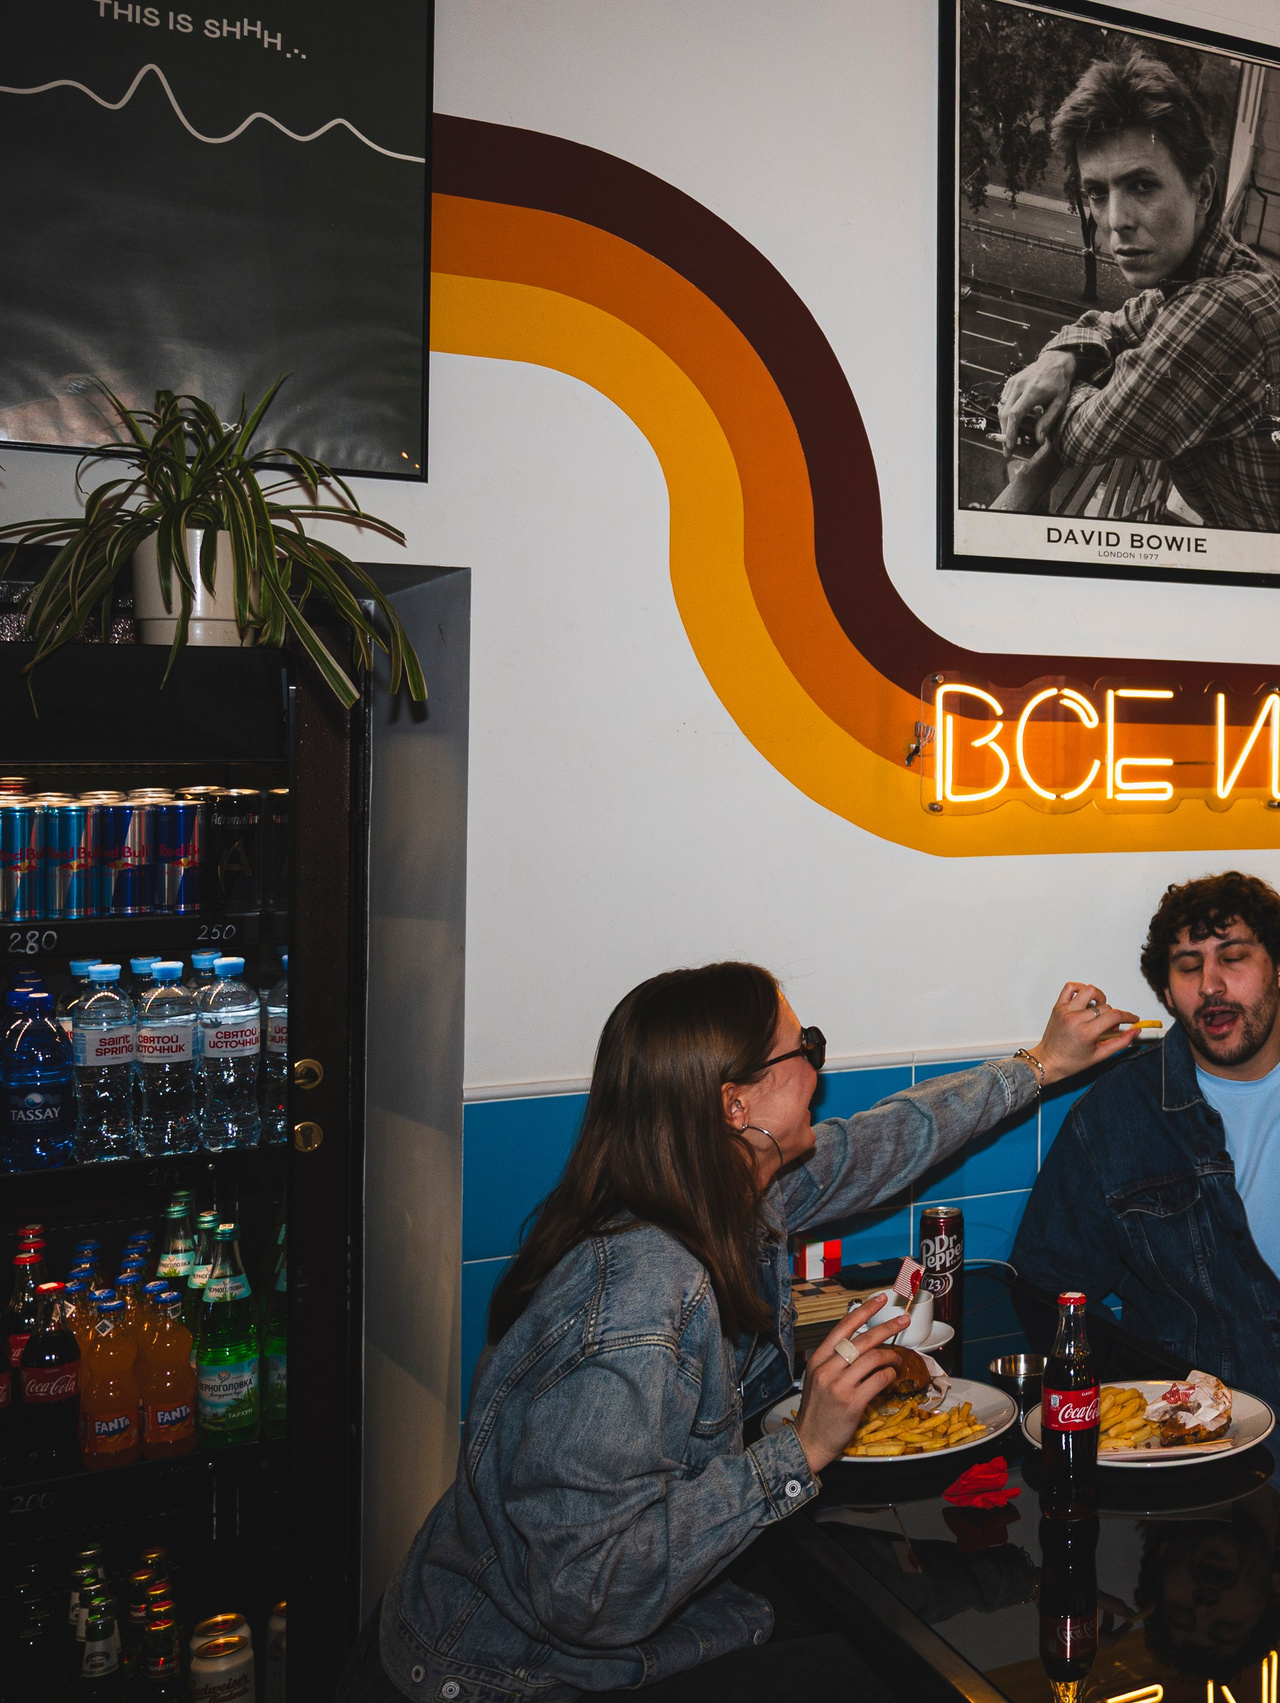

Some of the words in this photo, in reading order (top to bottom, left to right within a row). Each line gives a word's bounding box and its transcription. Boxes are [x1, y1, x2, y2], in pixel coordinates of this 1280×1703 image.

[93, 0, 161, 27] THIS
[168, 11, 194, 33] IS
[1046, 527, 1120, 547] DAVID
[1130, 533, 1207, 553] BOWIE
[1098, 550, 1136, 559] LONDON
[1139, 553, 1159, 561] 1977
[935, 683, 1174, 802] ВСЕ
[196, 924, 236, 940] 250
[8, 930, 57, 954] 280
[137, 1033, 179, 1045] СВЯТОЙ
[215, 1026, 257, 1040] СВЯТОЙ
[136, 1043, 186, 1054] СТОЧНИК
[208, 1038, 259, 1050] ИСТОЧНИК
[10, 1106, 61, 1121] TASSAY
[934, 1234, 957, 1254] Dr
[928, 1278, 941, 1292] 23
[157, 1404, 191, 1424] FANTA
[227, 1408, 254, 1420] ТАРХУН
[95, 1416, 131, 1434] FANTA
[9, 1492, 56, 1513] 200
